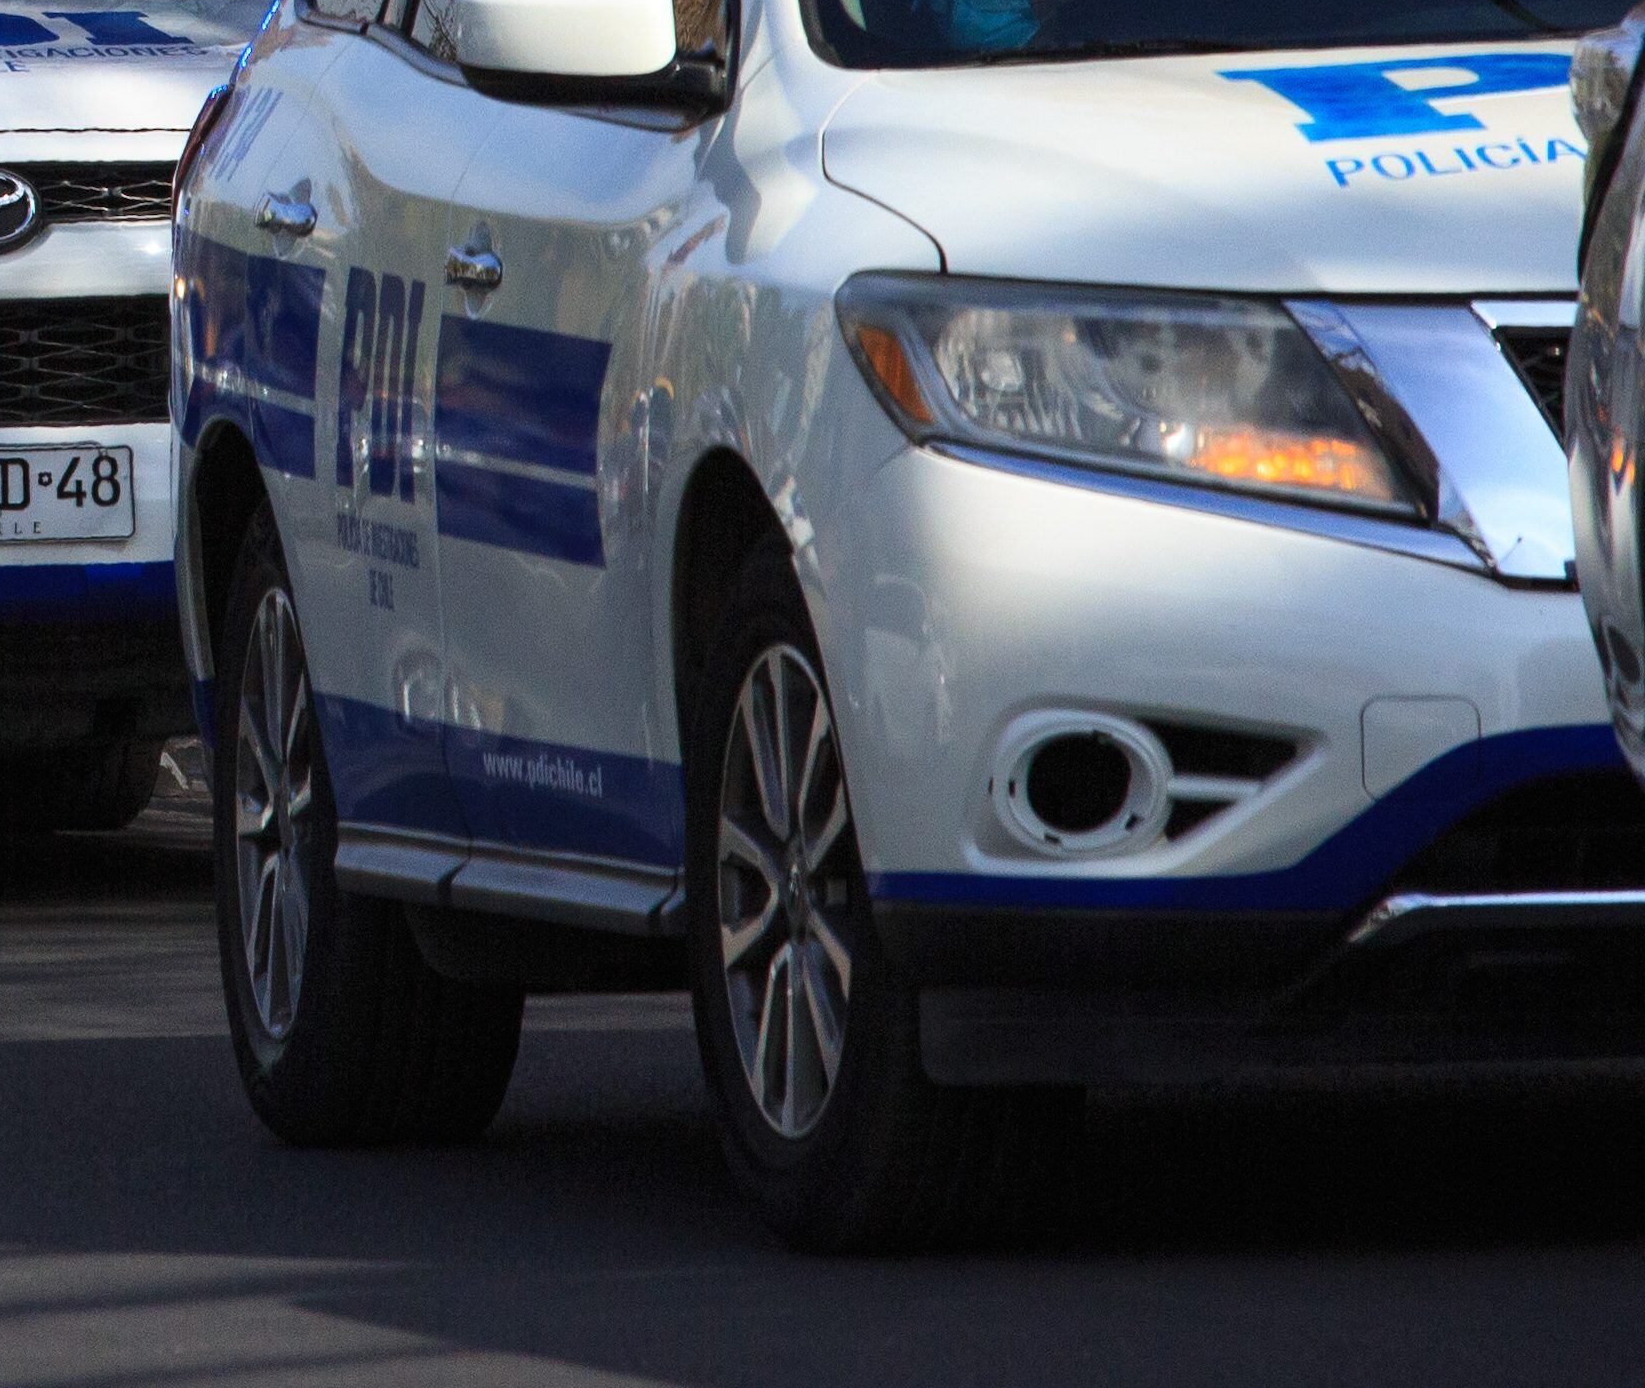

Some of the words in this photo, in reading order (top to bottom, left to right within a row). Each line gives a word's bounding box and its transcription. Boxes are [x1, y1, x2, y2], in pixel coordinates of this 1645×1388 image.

[1325, 136, 1588, 188] POLICÍA
[336, 266, 426, 505] PDI
[483, 753, 603, 798] www.pdichile.cl
